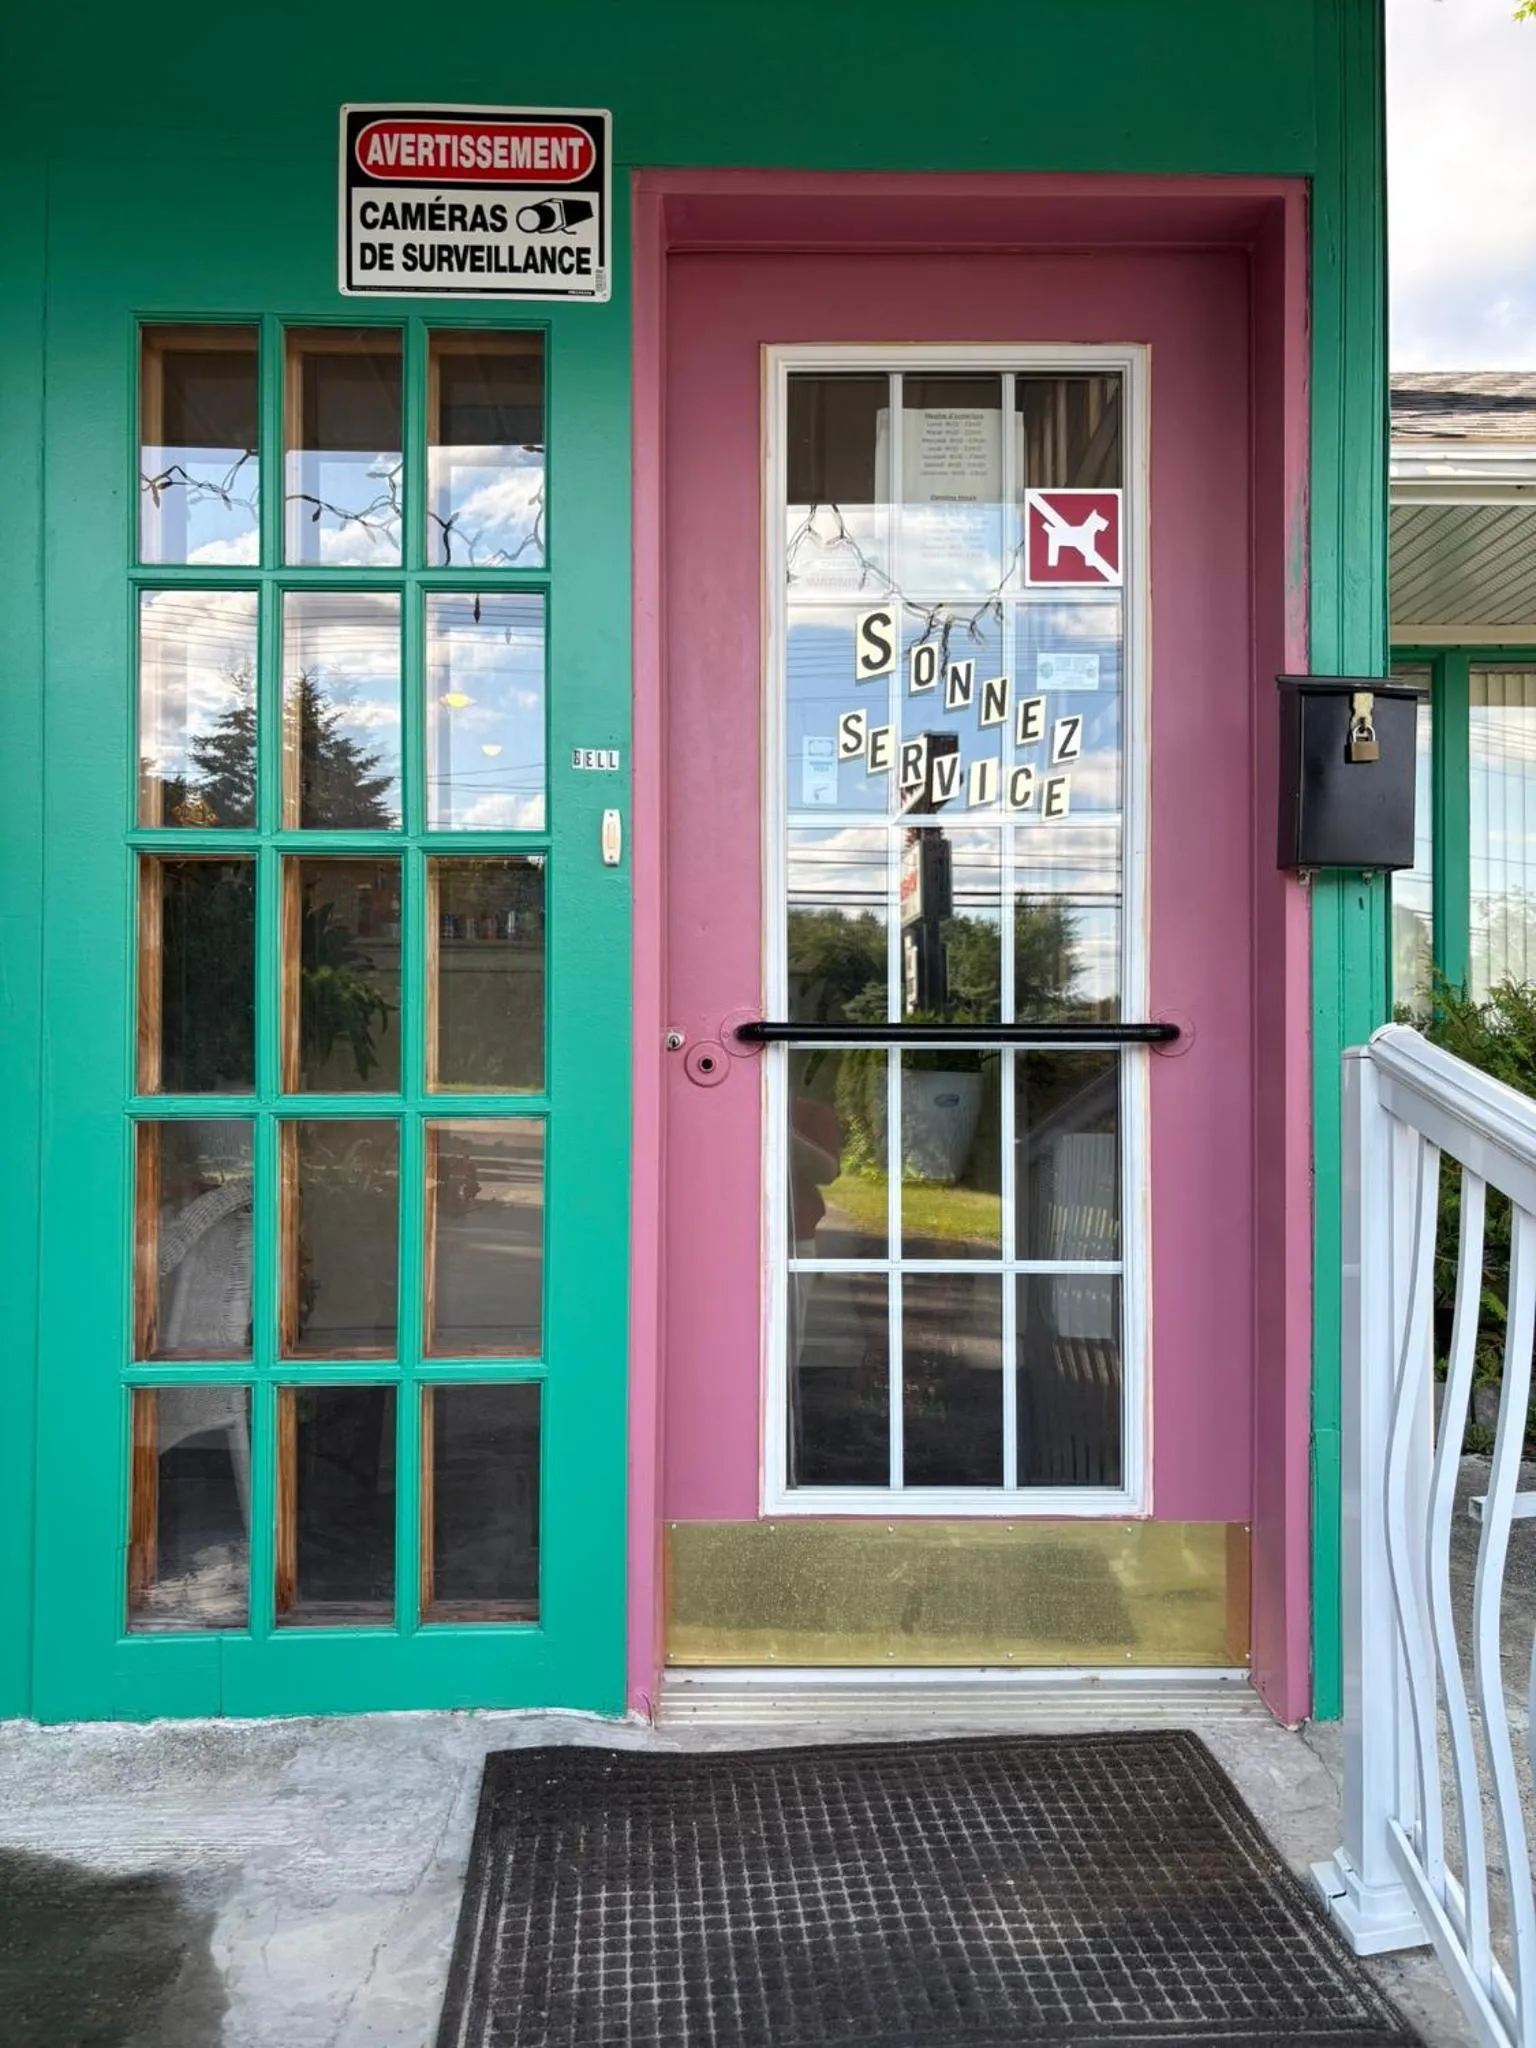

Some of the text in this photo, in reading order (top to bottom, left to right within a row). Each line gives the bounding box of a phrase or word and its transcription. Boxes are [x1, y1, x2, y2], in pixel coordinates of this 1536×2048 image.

[366, 132, 584, 171] AVERTISSEMENT
[359, 195, 508, 233] CAMÉRAS
[359, 242, 592, 275] DE SURVEILLANCE
[860, 611, 1081, 760] SONNEZ
[573, 749, 617, 768] BELL
[841, 713, 1066, 818] SERVICE
